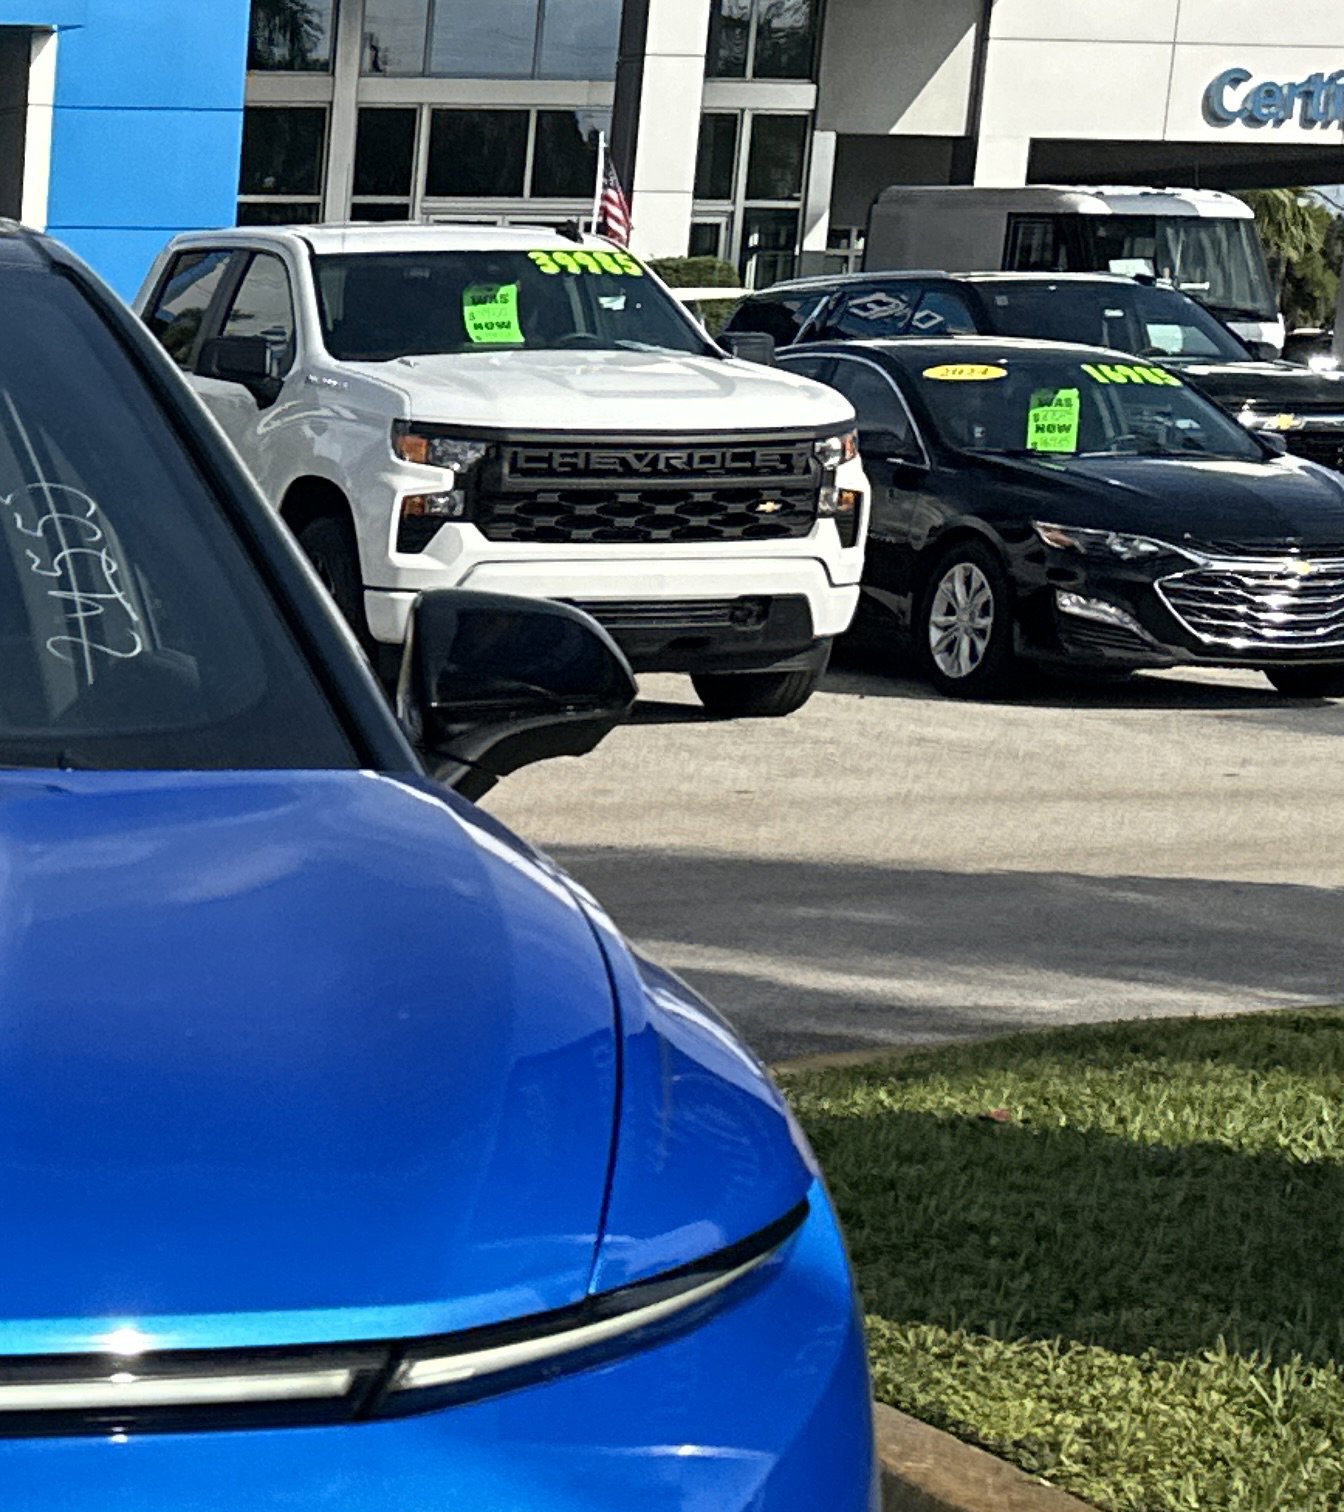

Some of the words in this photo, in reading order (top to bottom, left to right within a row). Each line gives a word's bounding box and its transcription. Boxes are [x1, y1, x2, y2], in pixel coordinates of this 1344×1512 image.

[527, 251, 643, 277] 39985
[1035, 423, 1072, 434] NOW
[516, 450, 812, 474] CHEVROLET
